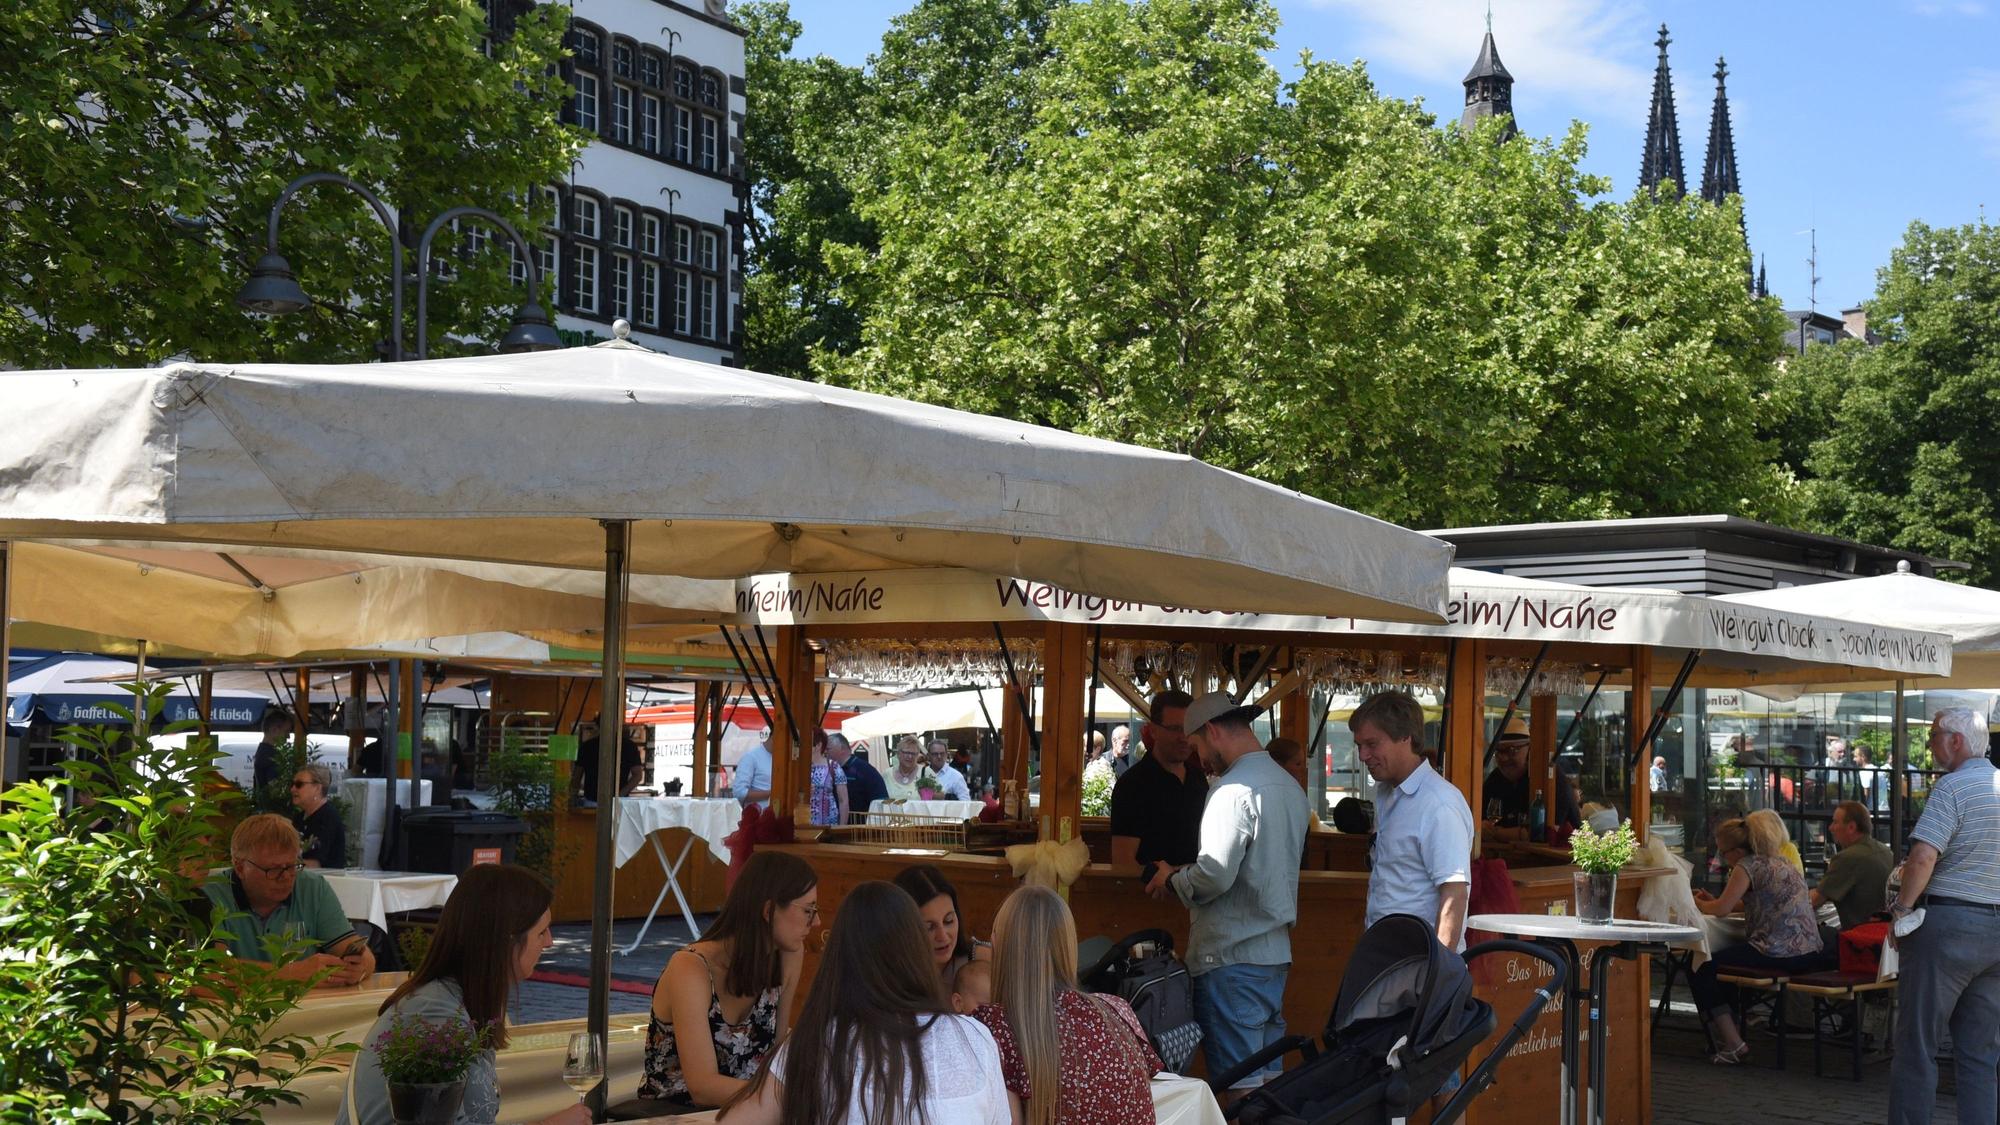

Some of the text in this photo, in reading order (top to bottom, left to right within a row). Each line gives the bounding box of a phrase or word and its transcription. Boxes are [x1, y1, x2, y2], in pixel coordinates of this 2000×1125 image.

[736, 577, 884, 618] nheim/Nahe
[1448, 592, 1617, 632] eim/Nahe
[1710, 608, 1774, 651] Weingut
[1839, 627, 1938, 665] Sponheim/Nahe
[1507, 957, 1532, 983] Das
